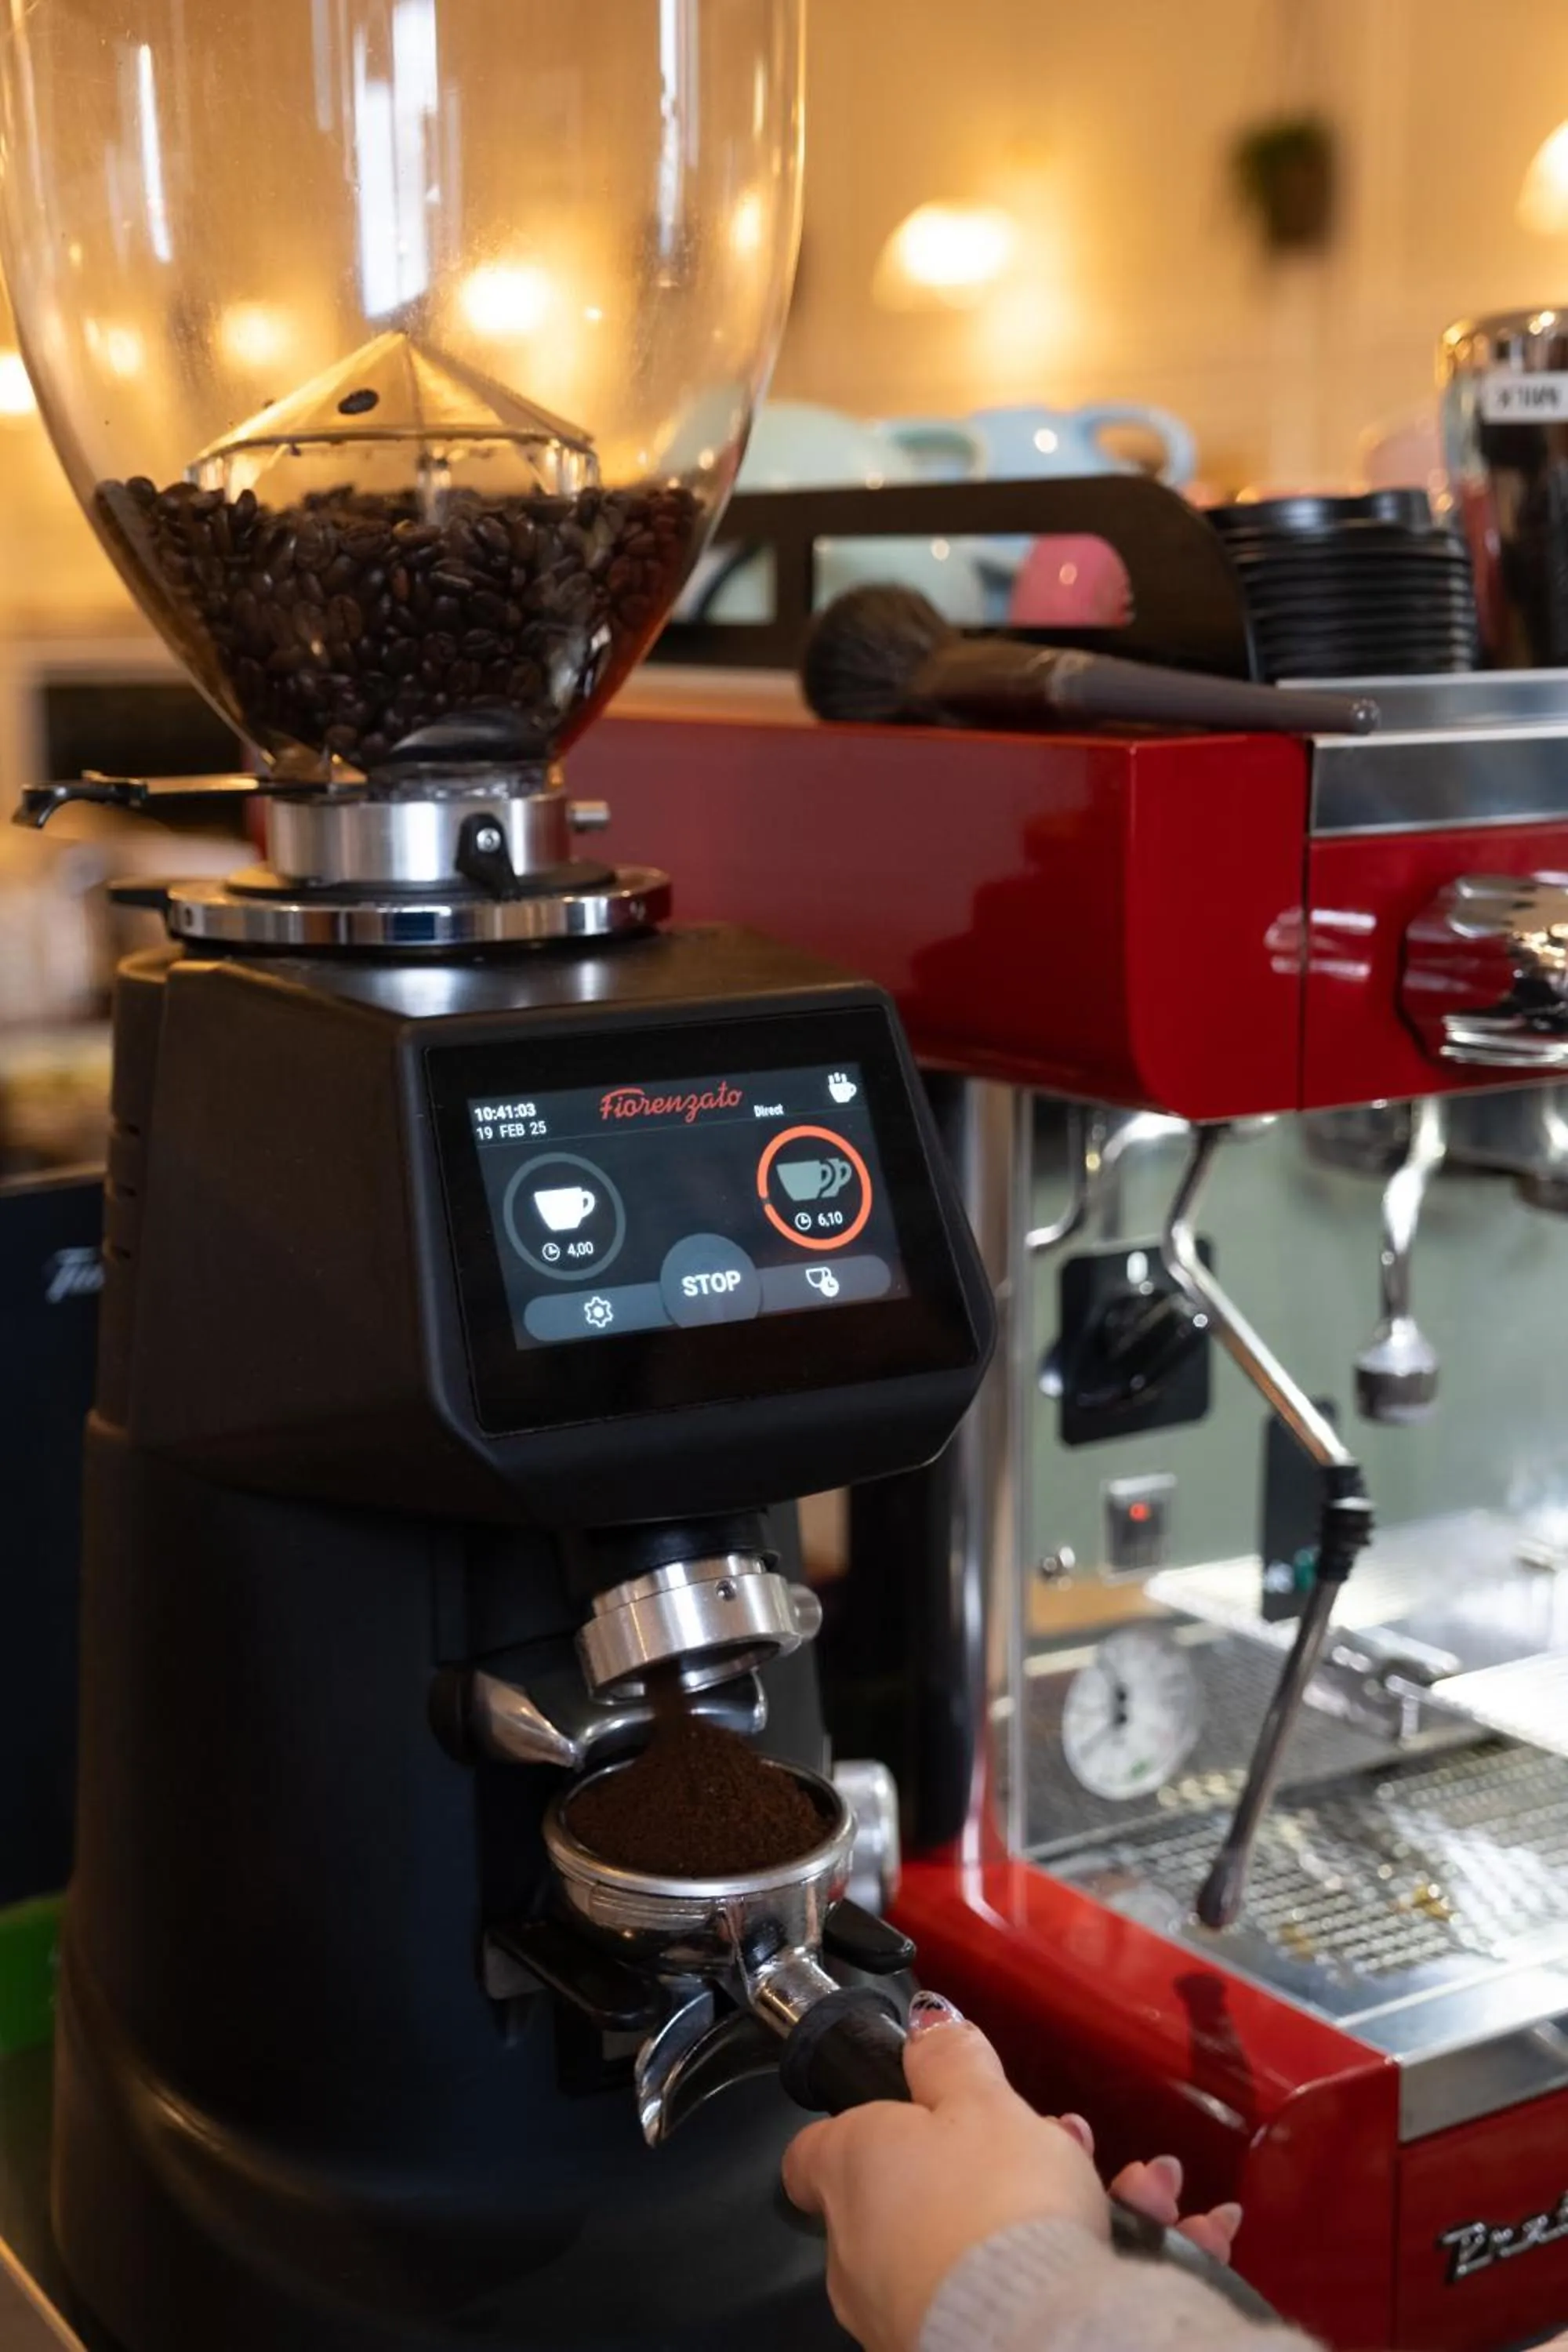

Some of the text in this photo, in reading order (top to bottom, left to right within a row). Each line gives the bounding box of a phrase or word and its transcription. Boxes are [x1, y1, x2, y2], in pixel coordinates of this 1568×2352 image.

[601, 1080, 742, 1123] Fiorenzato
[753, 1103, 784, 1117] Direct
[474, 1102, 536, 1122] 10:41:03
[476, 1120, 546, 1140] 19 FEB 25
[818, 1210, 843, 1227] 6,10
[567, 1241, 593, 1258] 4,00
[681, 1270, 741, 1297] STOP
